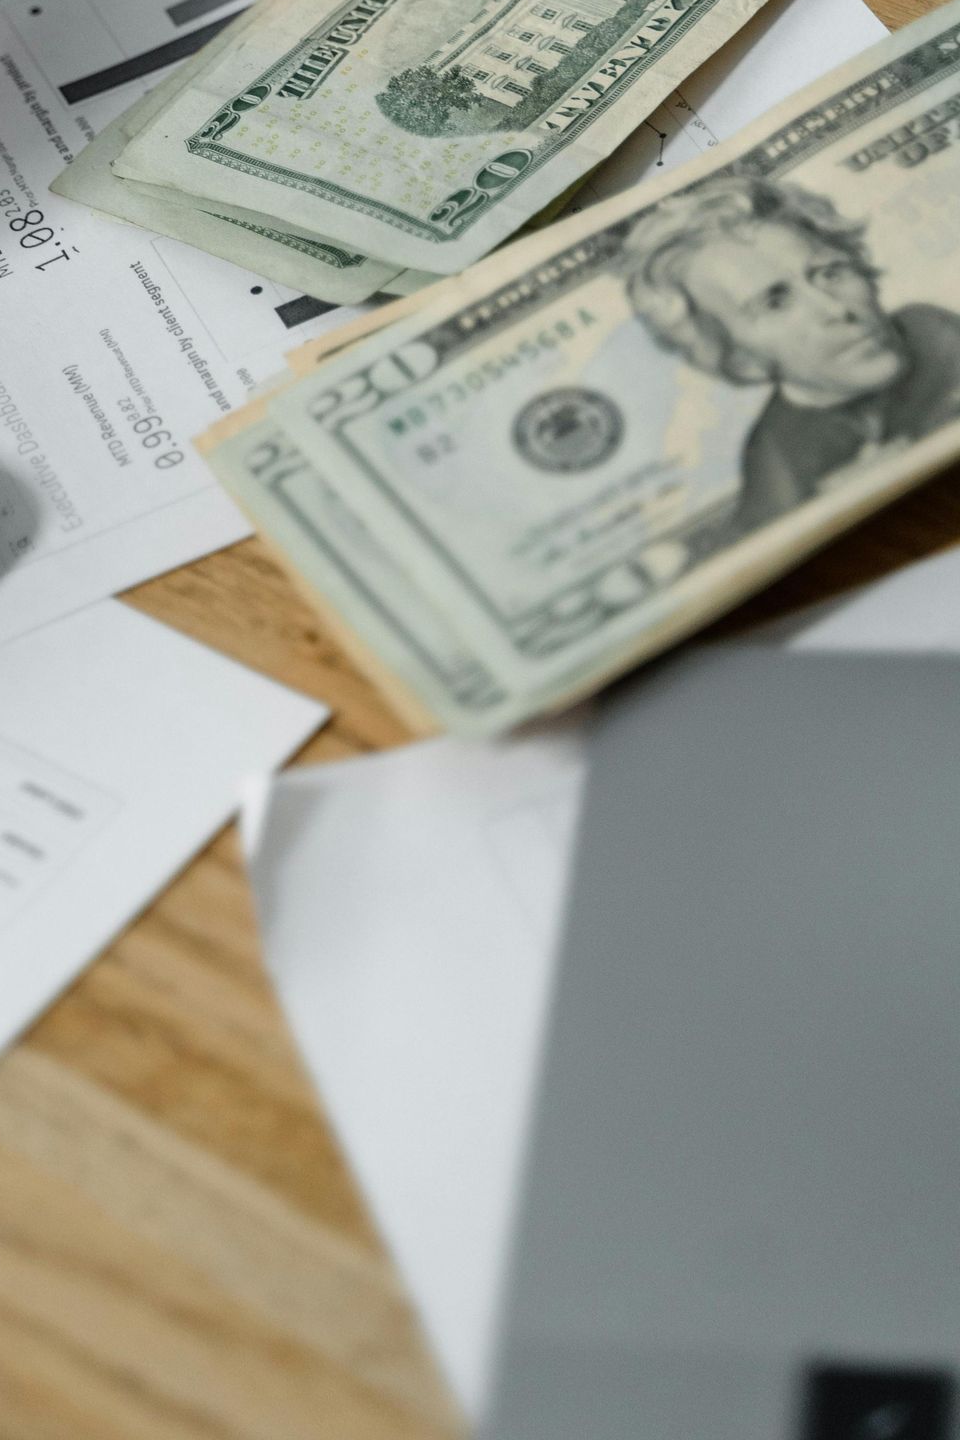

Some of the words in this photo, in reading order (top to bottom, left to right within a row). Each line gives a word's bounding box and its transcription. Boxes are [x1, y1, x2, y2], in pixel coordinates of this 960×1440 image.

[277, 43, 346, 99] THE
[23, 90, 36, 105] by
[200, 84, 272, 141] 20
[765, 72, 901, 158] RESERVE
[30, 102, 57, 136] margin
[48, 135, 69, 154] and
[428, 148, 533, 228] 20
[9, 209, 70, 271] 1.08
[129, 261, 164, 306] segment
[158, 306, 184, 336] client
[112, 347, 135, 379] Revenue
[178, 338, 193, 352] by
[62, 365, 91, 394] (MM)
[129, 377, 145, 396] MTD
[187, 351, 217, 390] margin
[82, 393, 116, 440] Revenue
[208, 390, 231, 412] and
[107, 440, 132, 467] MTD
[133, 411, 184, 469] 0.99
[29, 455, 83, 533] Executive
